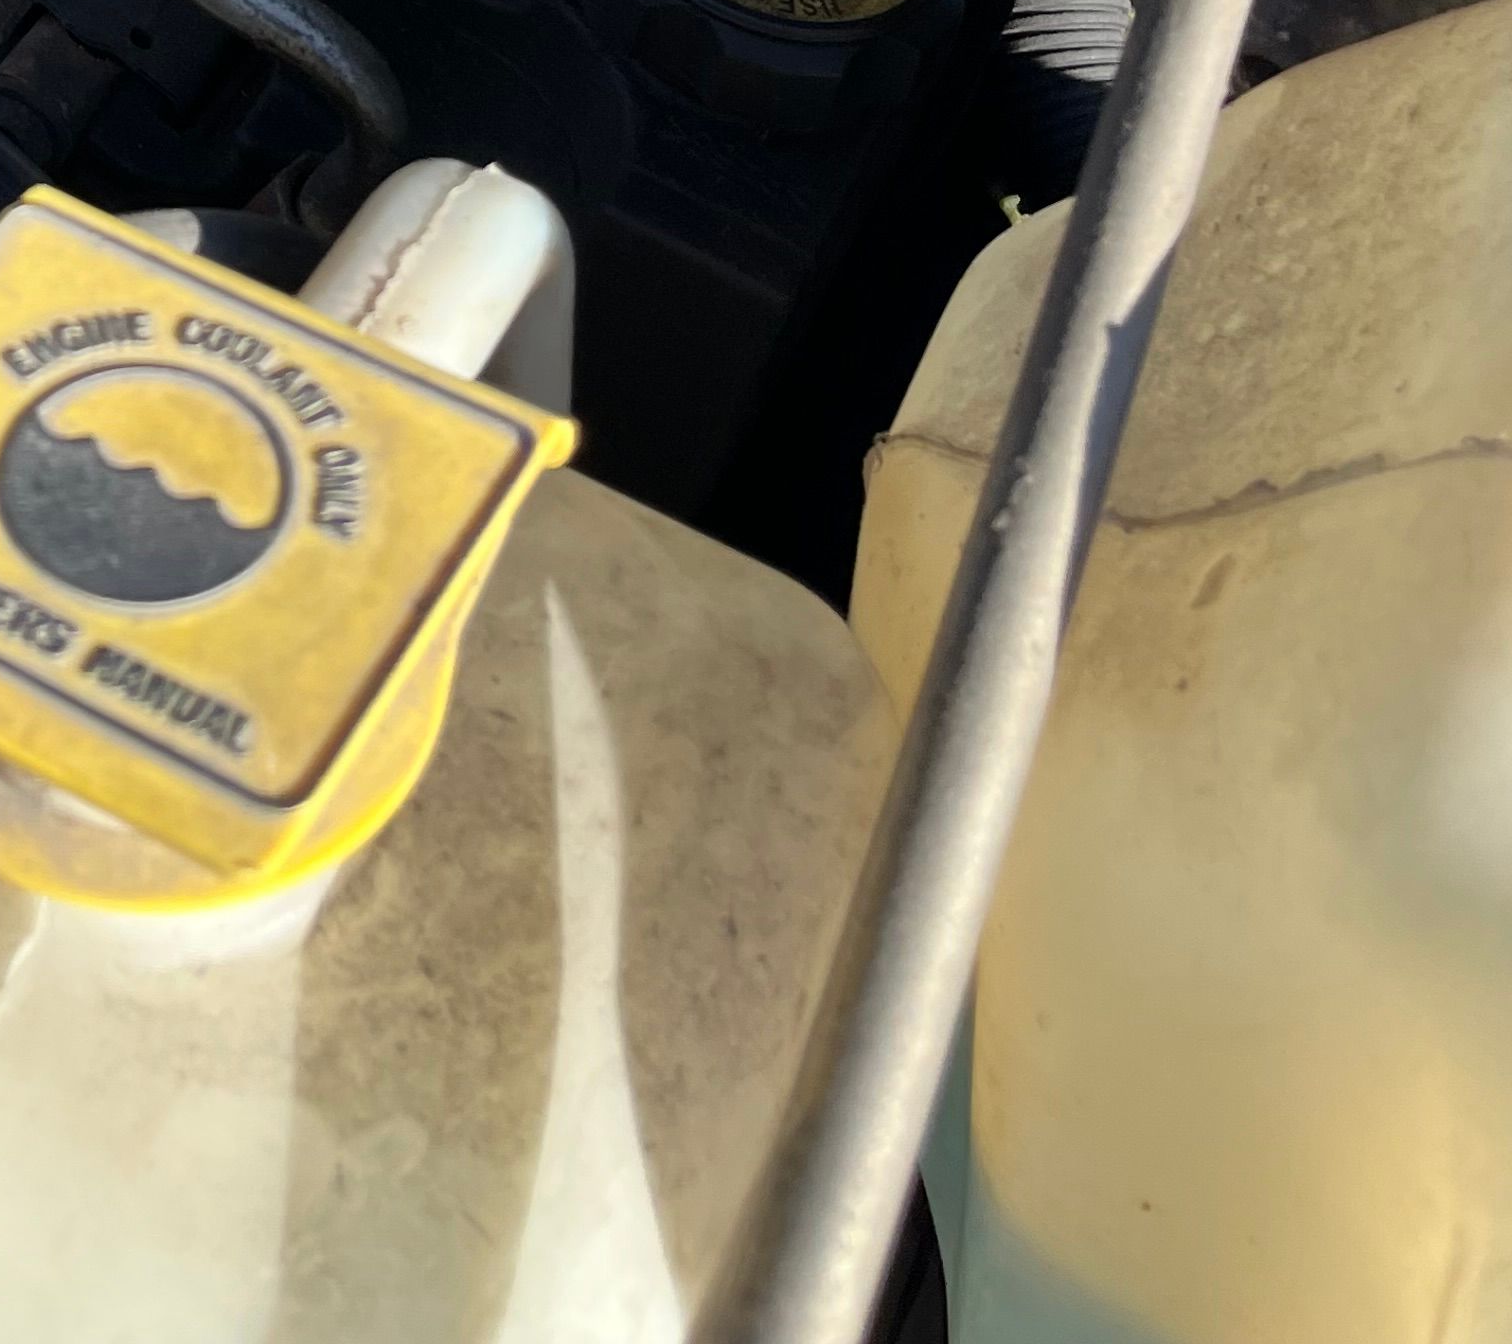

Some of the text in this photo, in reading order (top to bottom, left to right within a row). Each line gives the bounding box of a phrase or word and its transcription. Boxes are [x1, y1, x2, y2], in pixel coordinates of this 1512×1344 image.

[1, 312, 360, 537] ENGINE COOLANT ONLY
[80, 644, 251, 755] MANUAL
